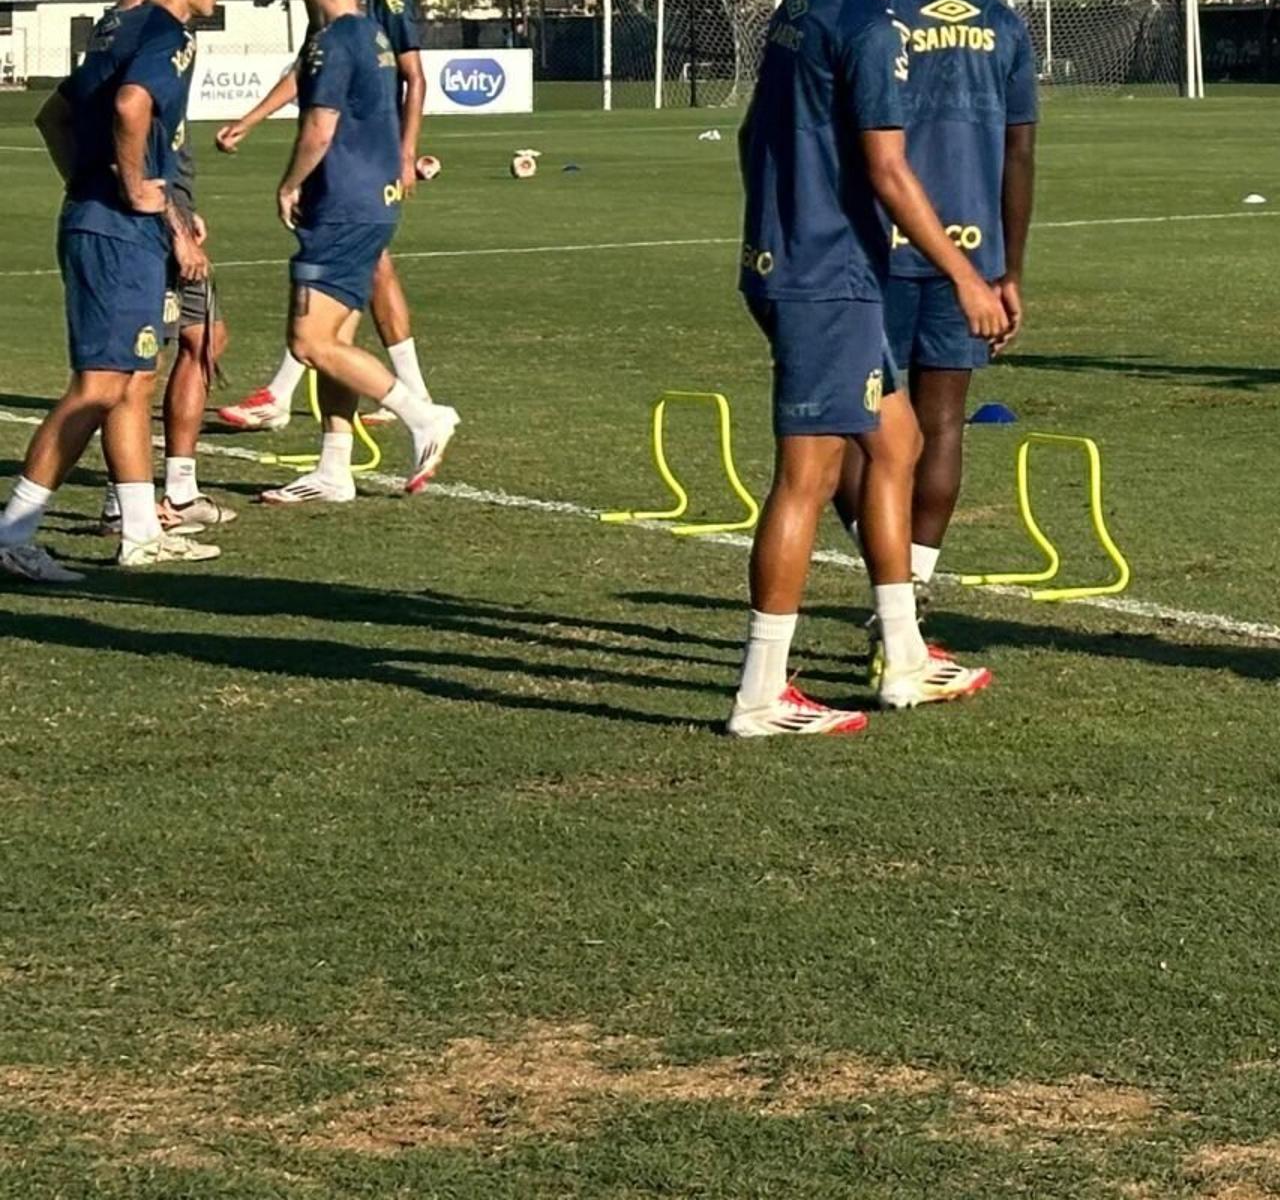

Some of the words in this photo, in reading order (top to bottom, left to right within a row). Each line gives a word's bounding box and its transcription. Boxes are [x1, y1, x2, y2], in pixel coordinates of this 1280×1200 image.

[912, 24, 996, 53] SANTOS
[202, 67, 262, 87] ÁGUA
[201, 89, 260, 100] MINERAL
